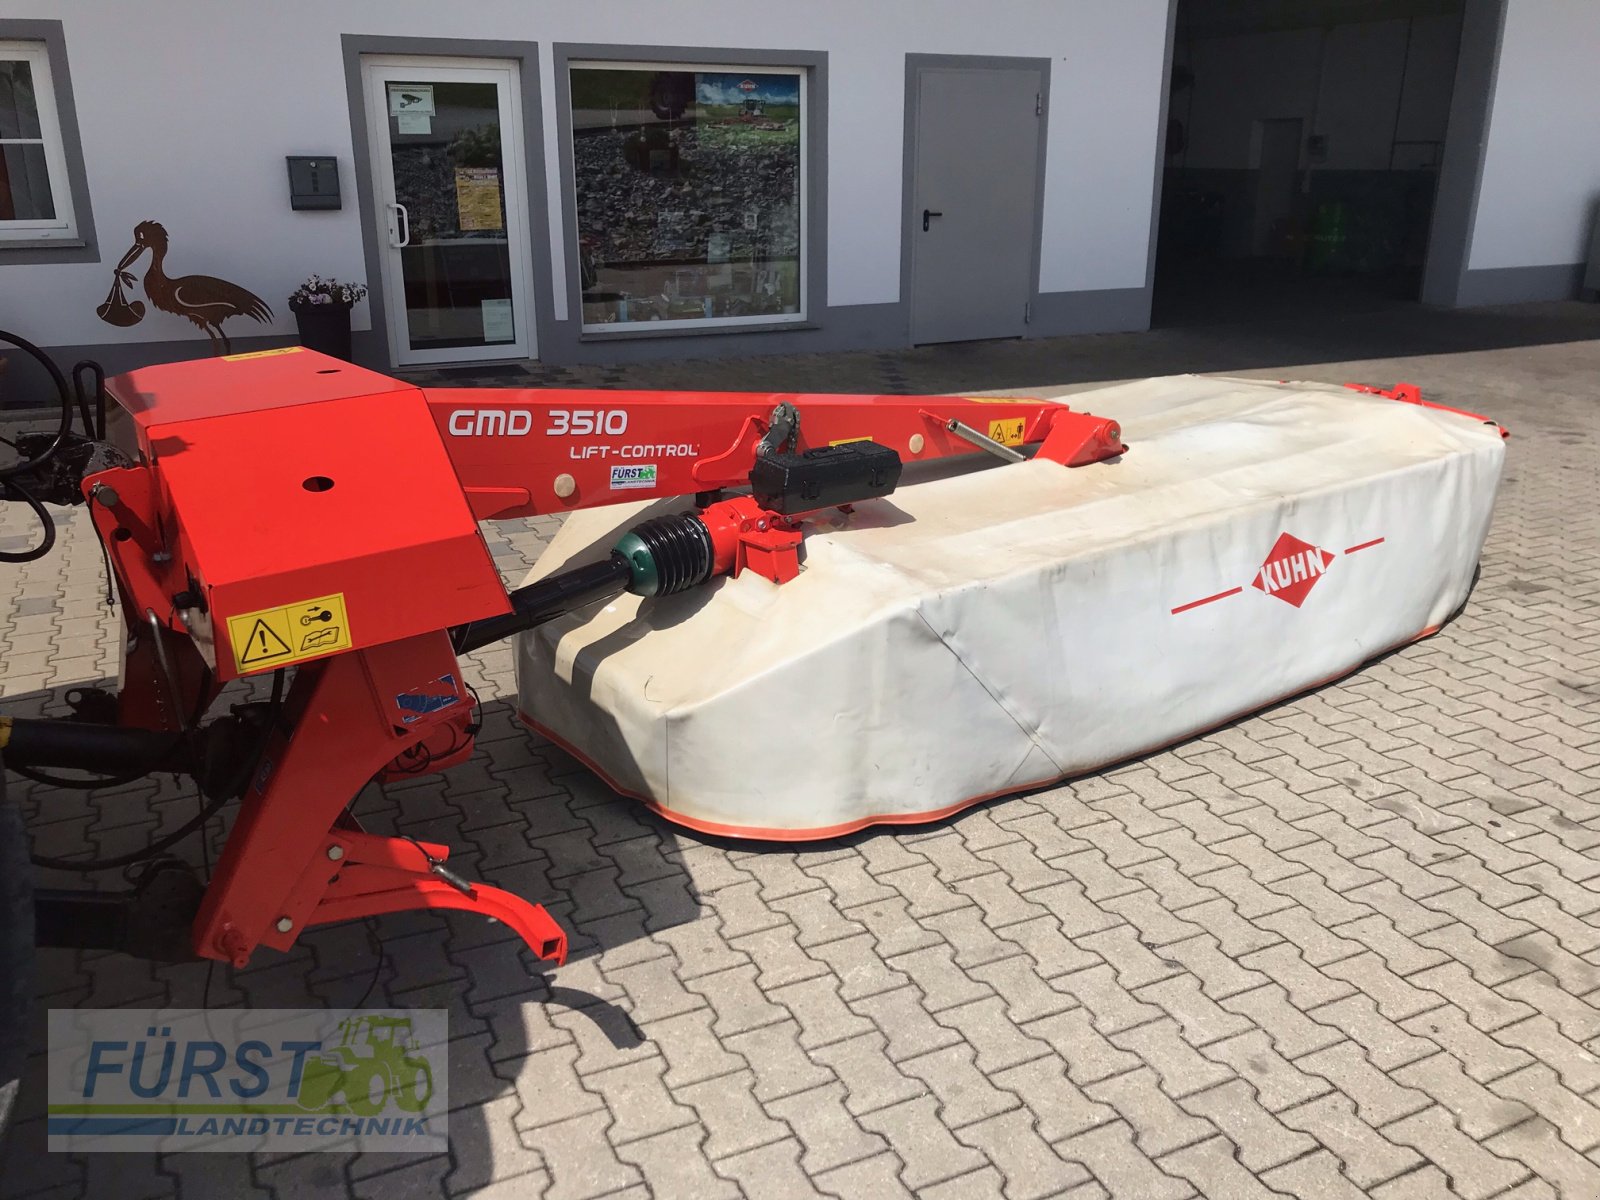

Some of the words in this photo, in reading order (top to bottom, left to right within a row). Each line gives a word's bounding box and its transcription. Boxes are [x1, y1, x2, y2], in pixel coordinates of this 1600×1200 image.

[449, 410, 532, 436] GMD
[546, 410, 628, 435] 3510
[570, 444, 698, 459] LIFT-CONTROL
[611, 467, 643, 479] FÜRST
[1259, 546, 1326, 595] KUHN
